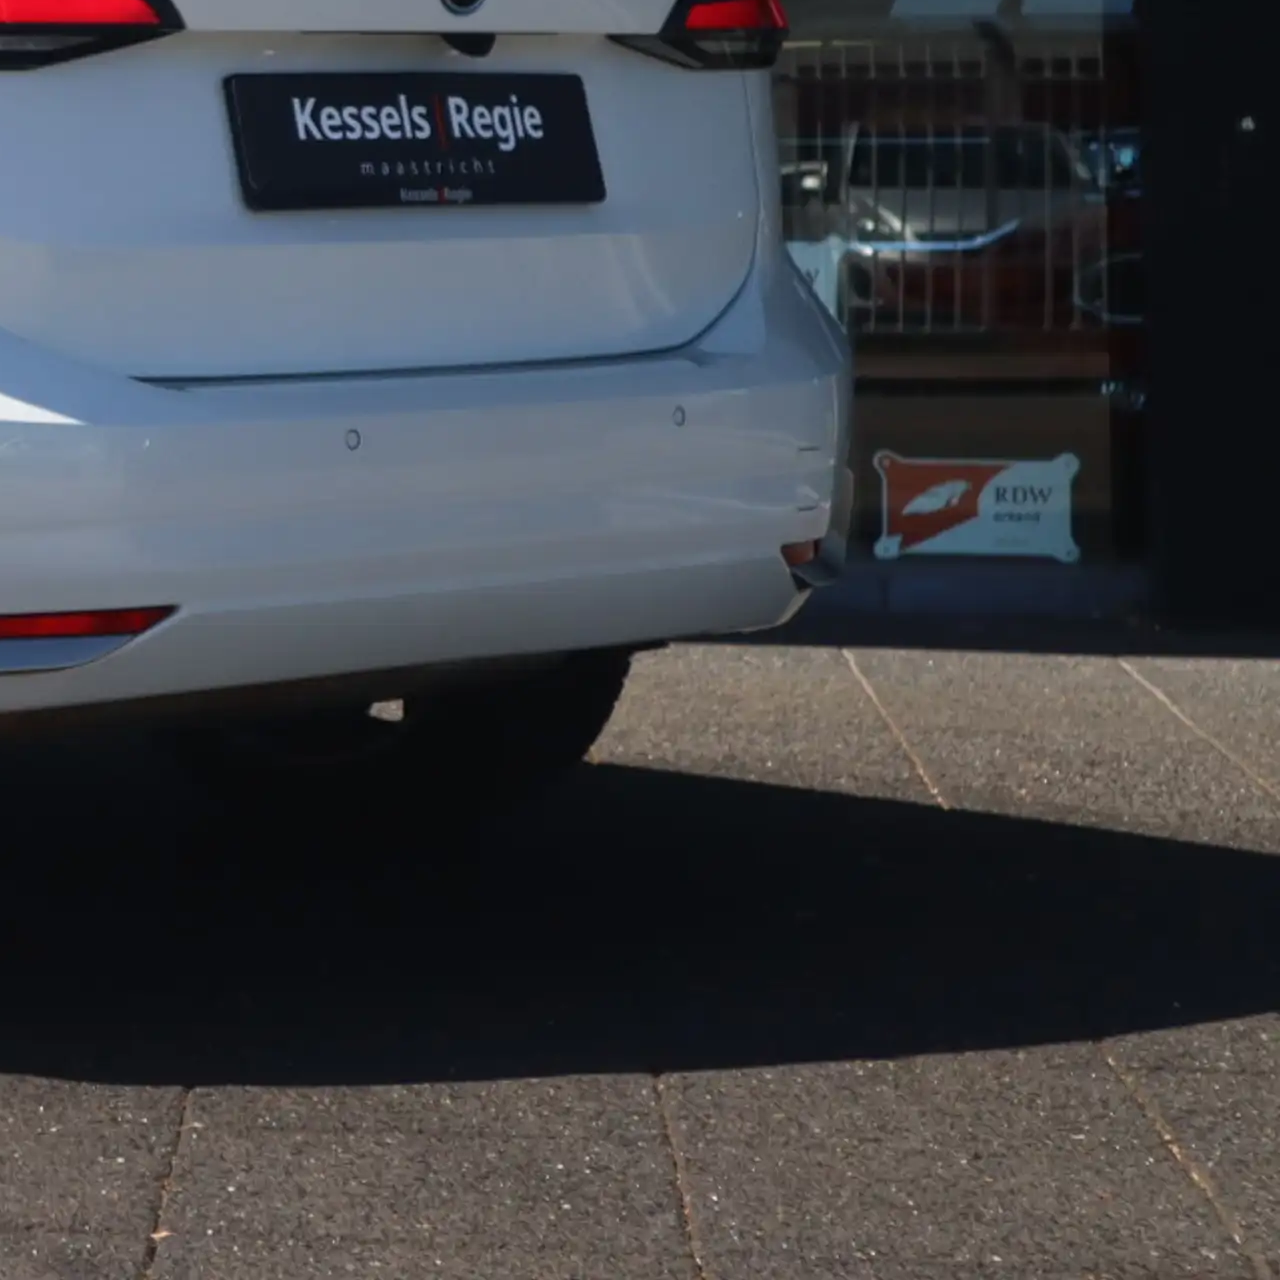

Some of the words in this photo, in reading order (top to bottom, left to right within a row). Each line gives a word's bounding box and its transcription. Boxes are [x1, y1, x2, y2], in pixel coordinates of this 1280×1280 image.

[292, 94, 432, 141] Kessels
[447, 94, 545, 152] Regie
[360, 156, 497, 176] maastricht
[995, 485, 1053, 505] RDW
